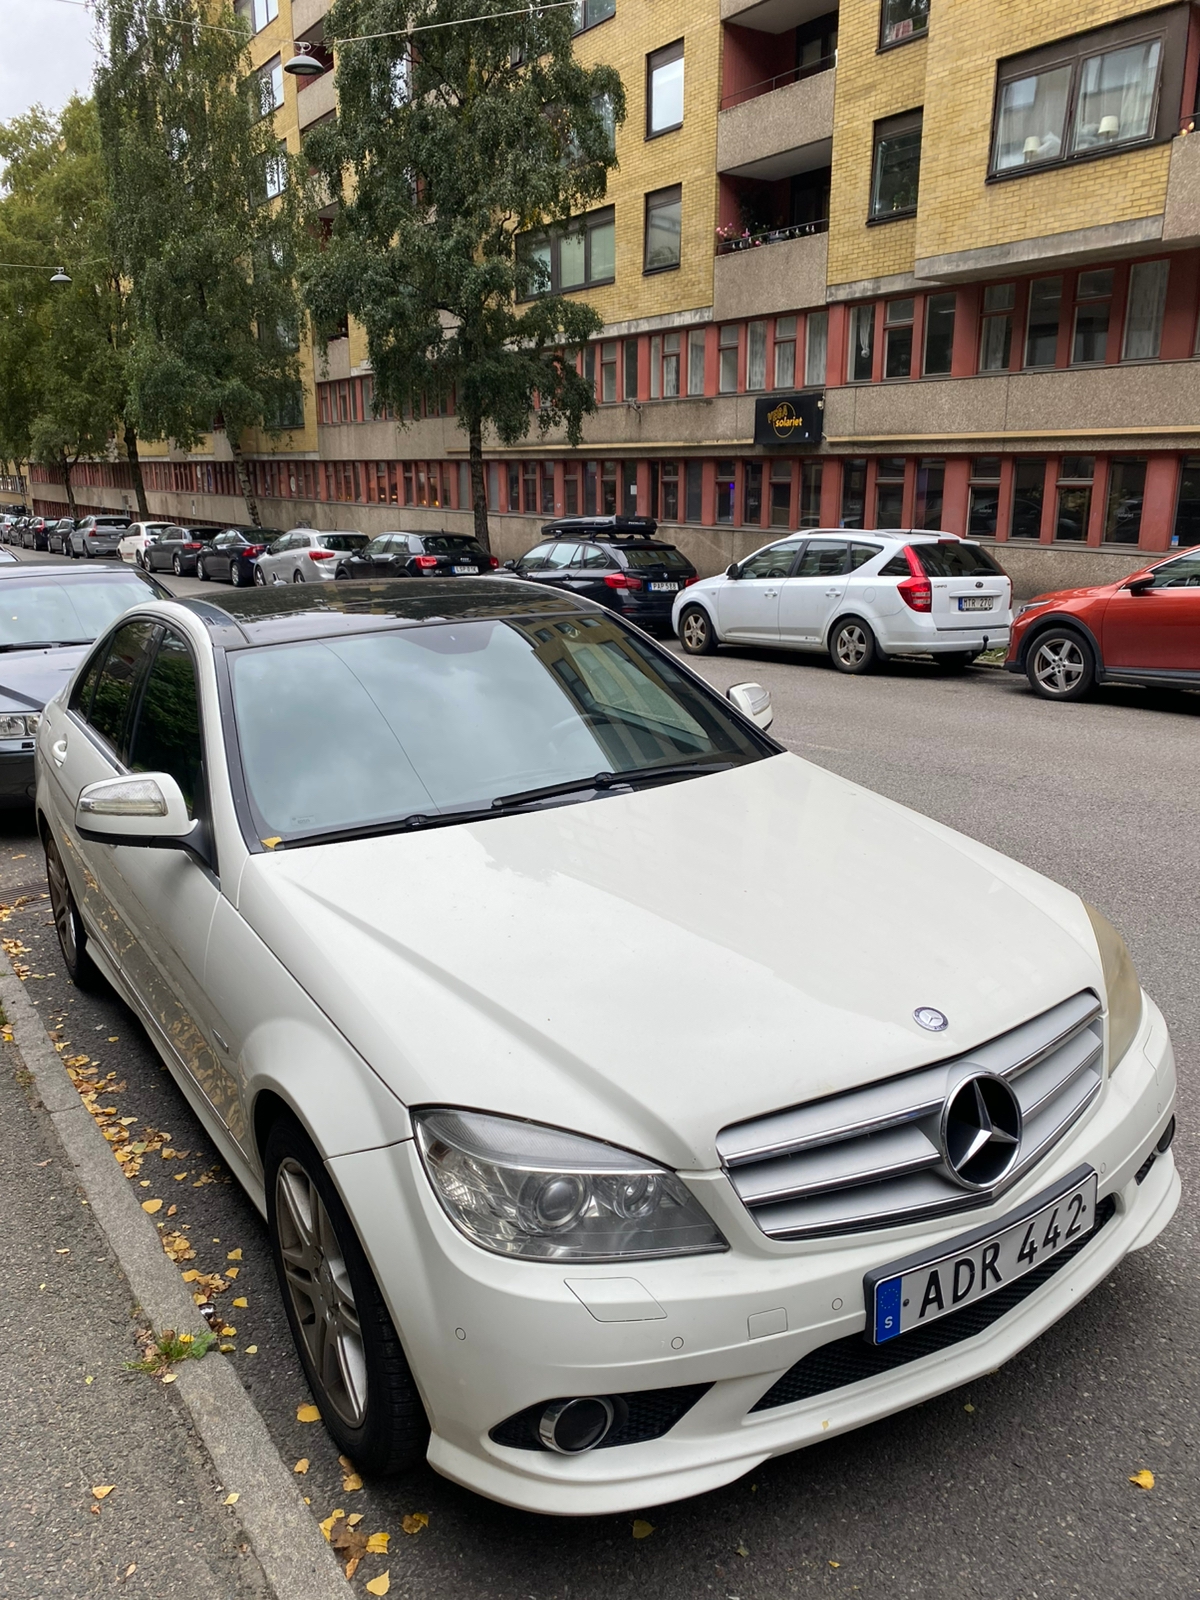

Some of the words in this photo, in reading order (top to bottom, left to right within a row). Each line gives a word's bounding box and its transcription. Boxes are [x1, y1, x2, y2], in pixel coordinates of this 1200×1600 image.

[775, 416, 803, 427] solariet
[964, 598, 976, 607] MTR
[918, 1241, 1003, 1319] ADR
[1016, 1193, 1084, 1265] 442
[884, 1315, 893, 1329] S
